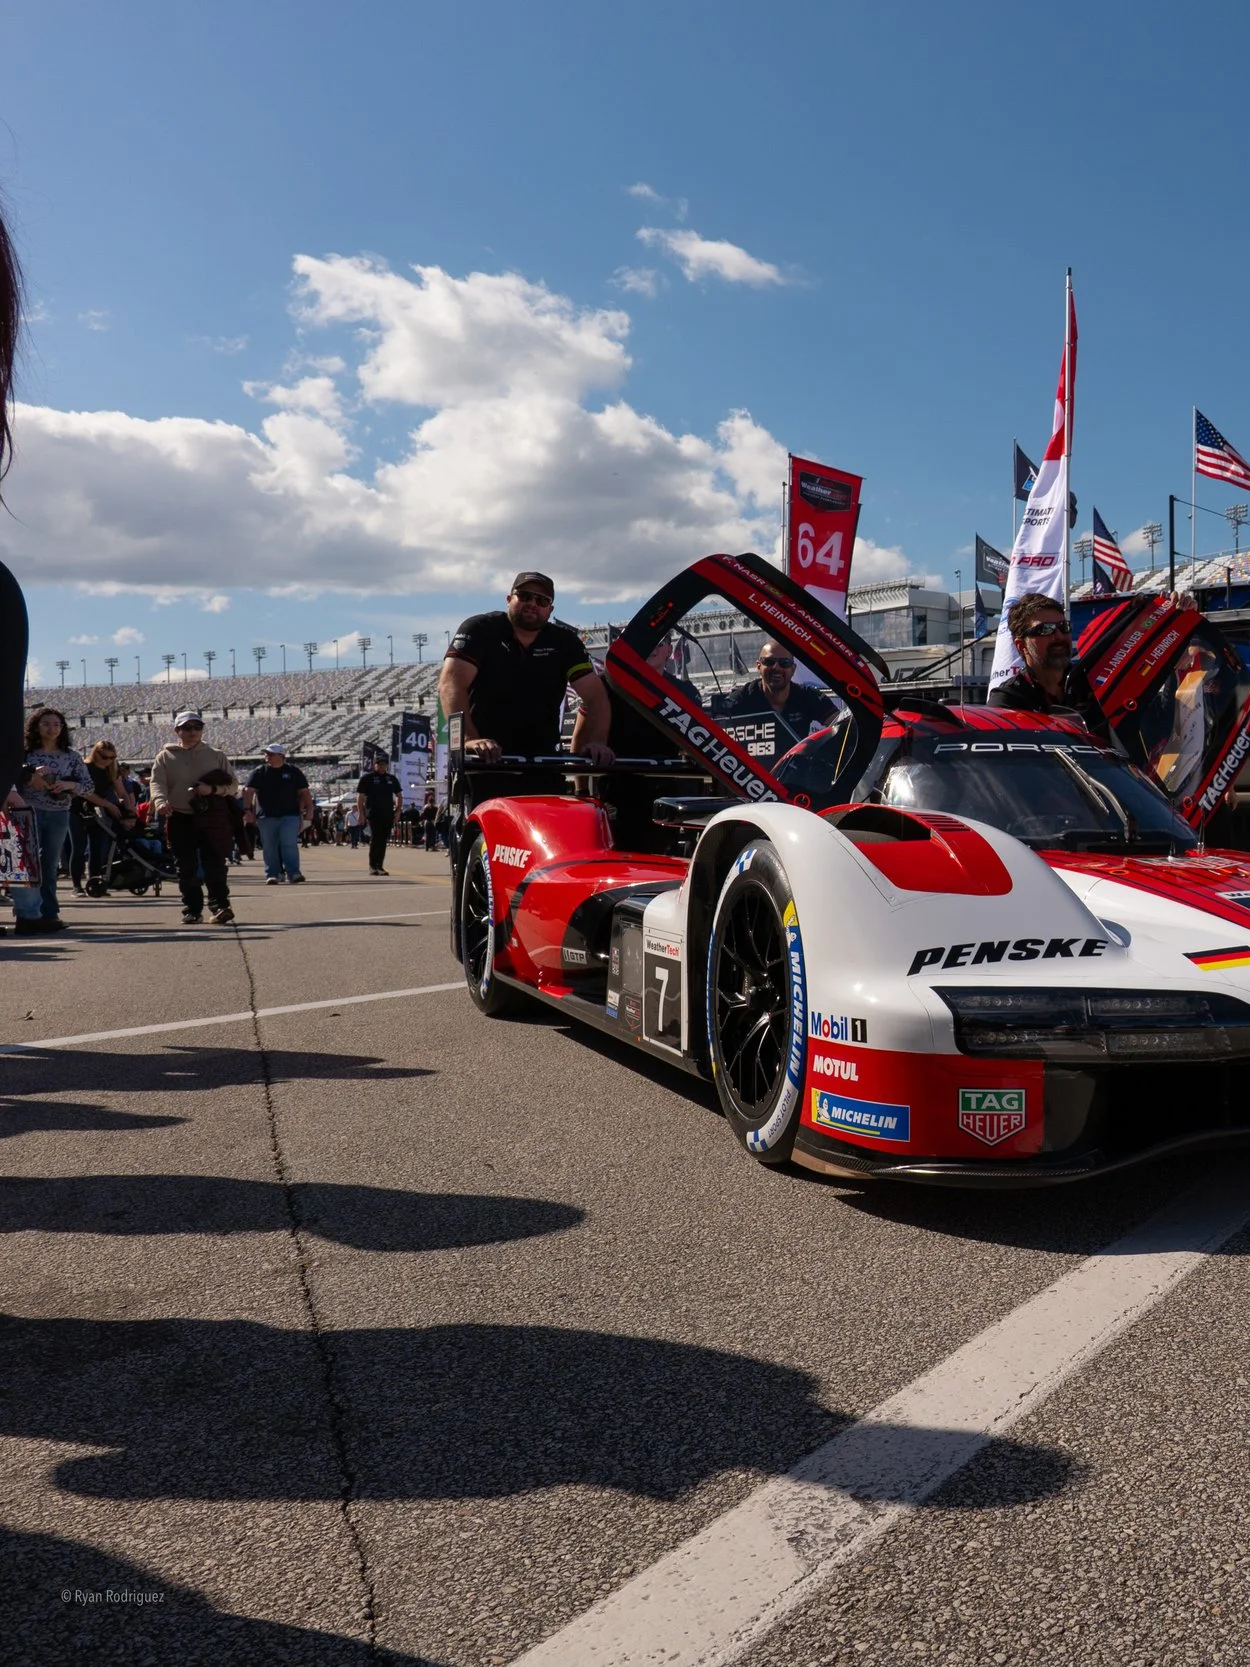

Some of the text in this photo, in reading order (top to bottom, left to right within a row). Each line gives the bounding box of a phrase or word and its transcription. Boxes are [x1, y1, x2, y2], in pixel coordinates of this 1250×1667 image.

[797, 522, 845, 577] 64
[1017, 556, 1056, 568] PRO
[733, 562, 767, 587] NASR
[748, 592, 812, 643] L. HEINRICH
[798, 609, 854, 658] ANDLAUER
[1150, 629, 1180, 660] HEINRICH
[1108, 630, 1145, 668] ANDLAUER
[405, 731, 427, 749] 40
[747, 741, 776, 757] 963
[492, 844, 533, 869] PENSKE
[569, 952, 585, 961] GTP
[646, 940, 680, 957] WeatherTech
[906, 938, 1109, 977] PENSKE
[655, 966, 669, 1032] 7
[789, 951, 805, 1079] MICHELIN
[811, 1011, 849, 1041] Mobil
[812, 1054, 859, 1082] MOTUL
[767, 1088, 792, 1138] PILOT SPORT
[964, 1092, 1020, 1111] TAG
[831, 1106, 898, 1130] MICHELIN
[962, 1113, 1021, 1141] HEUER
